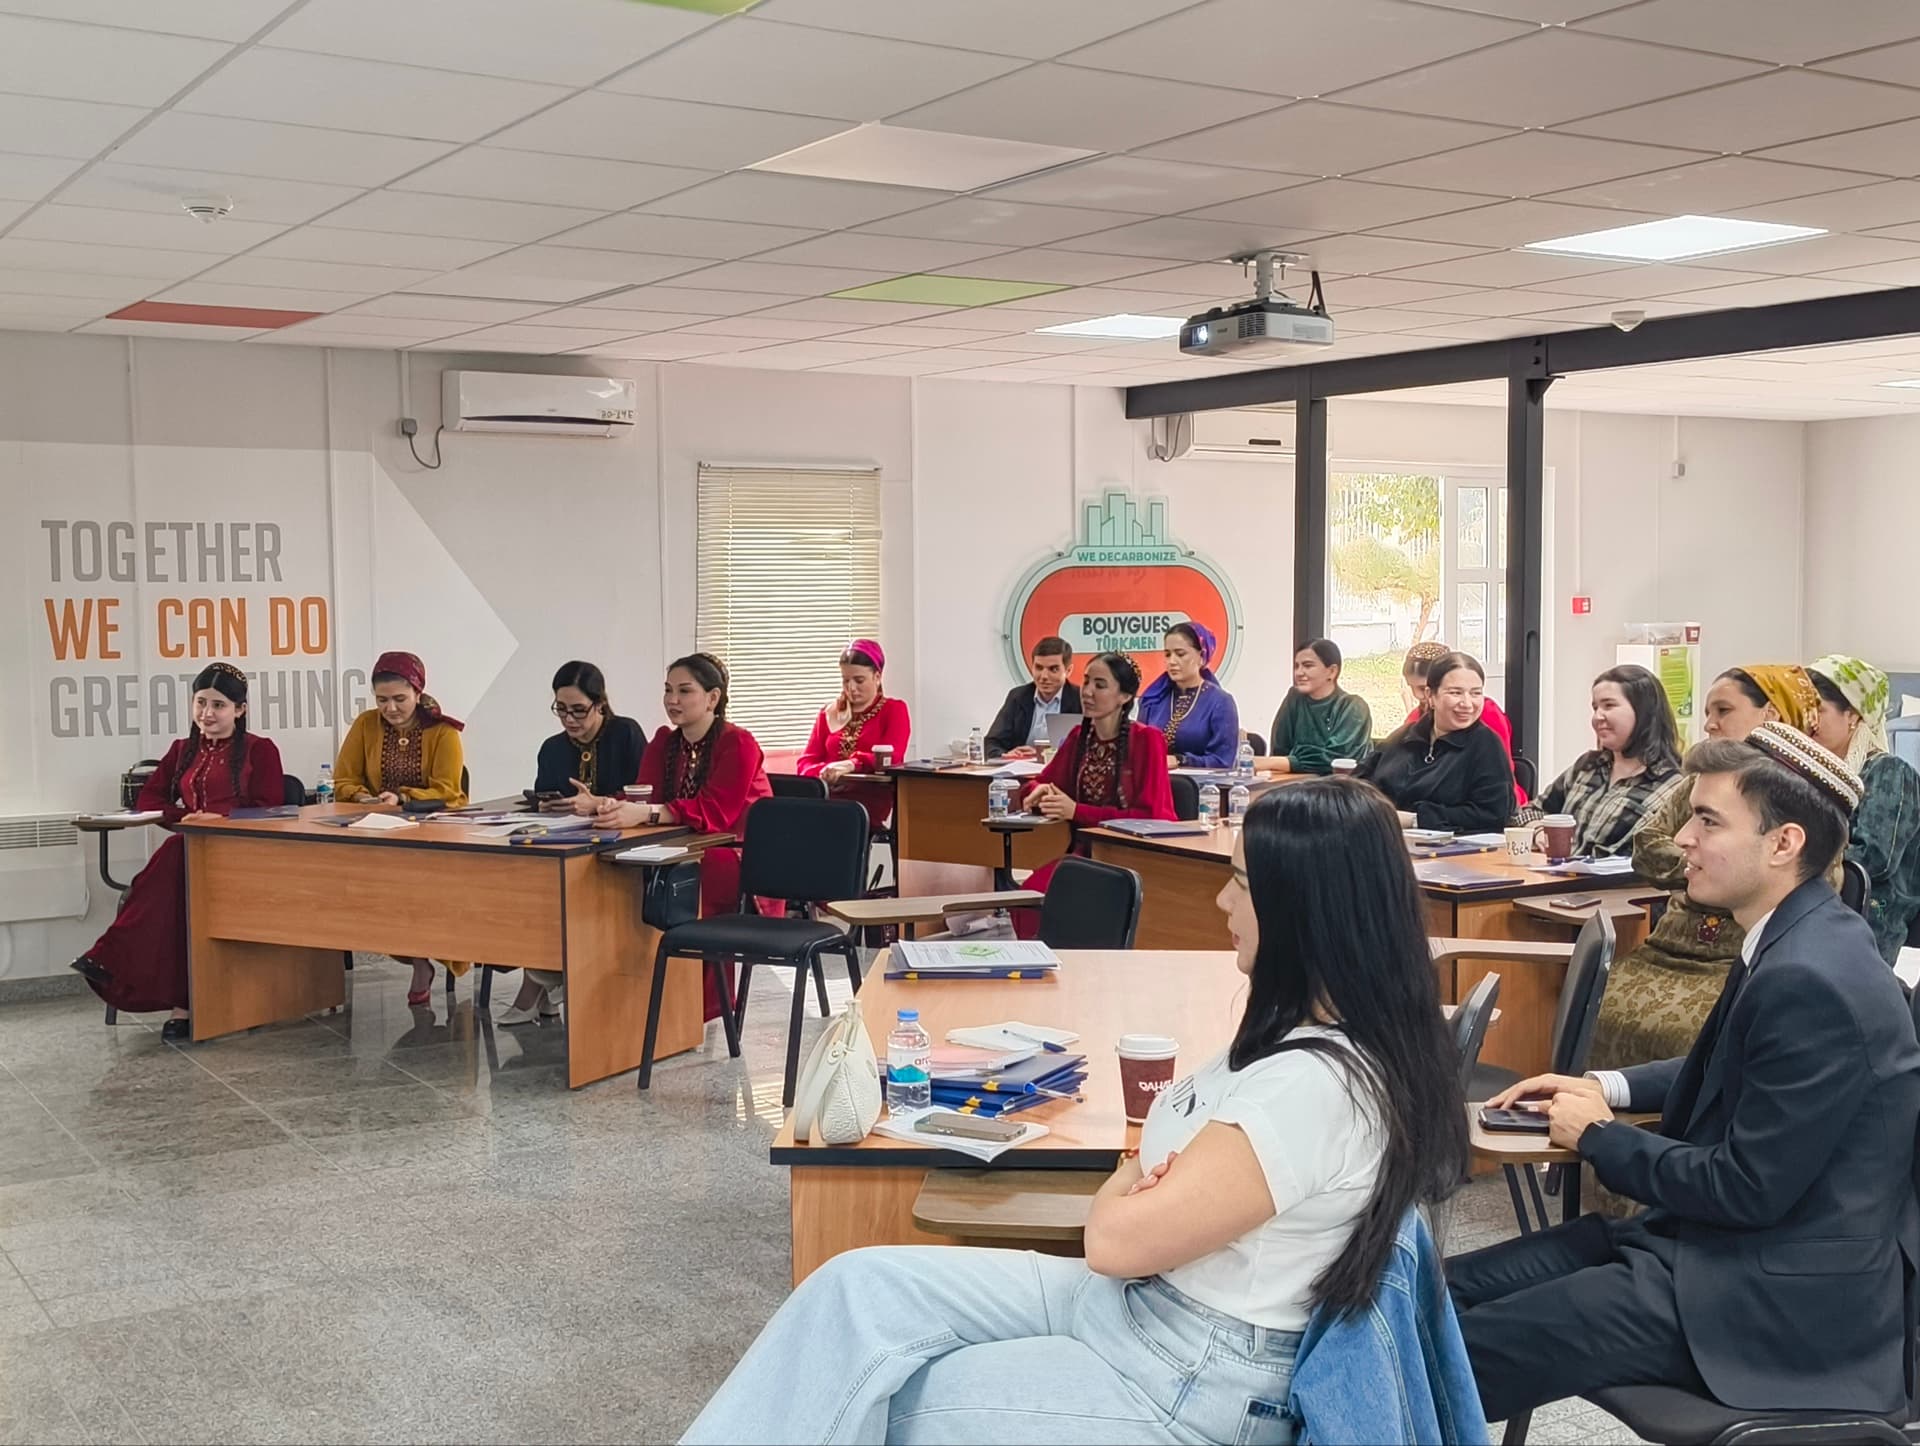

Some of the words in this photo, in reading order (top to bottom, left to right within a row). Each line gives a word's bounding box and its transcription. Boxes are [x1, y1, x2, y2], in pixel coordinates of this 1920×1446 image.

[41, 520, 283, 583] TOGETHER
[1077, 552, 1096, 562] WE
[1099, 551, 1176, 562] DECARBONIZE
[44, 598, 121, 661] WE
[158, 597, 248, 658] CAN
[269, 596, 329, 656] DO
[1083, 616, 1170, 636] BOUYGUES
[1096, 634, 1156, 651] TÜRKMEN
